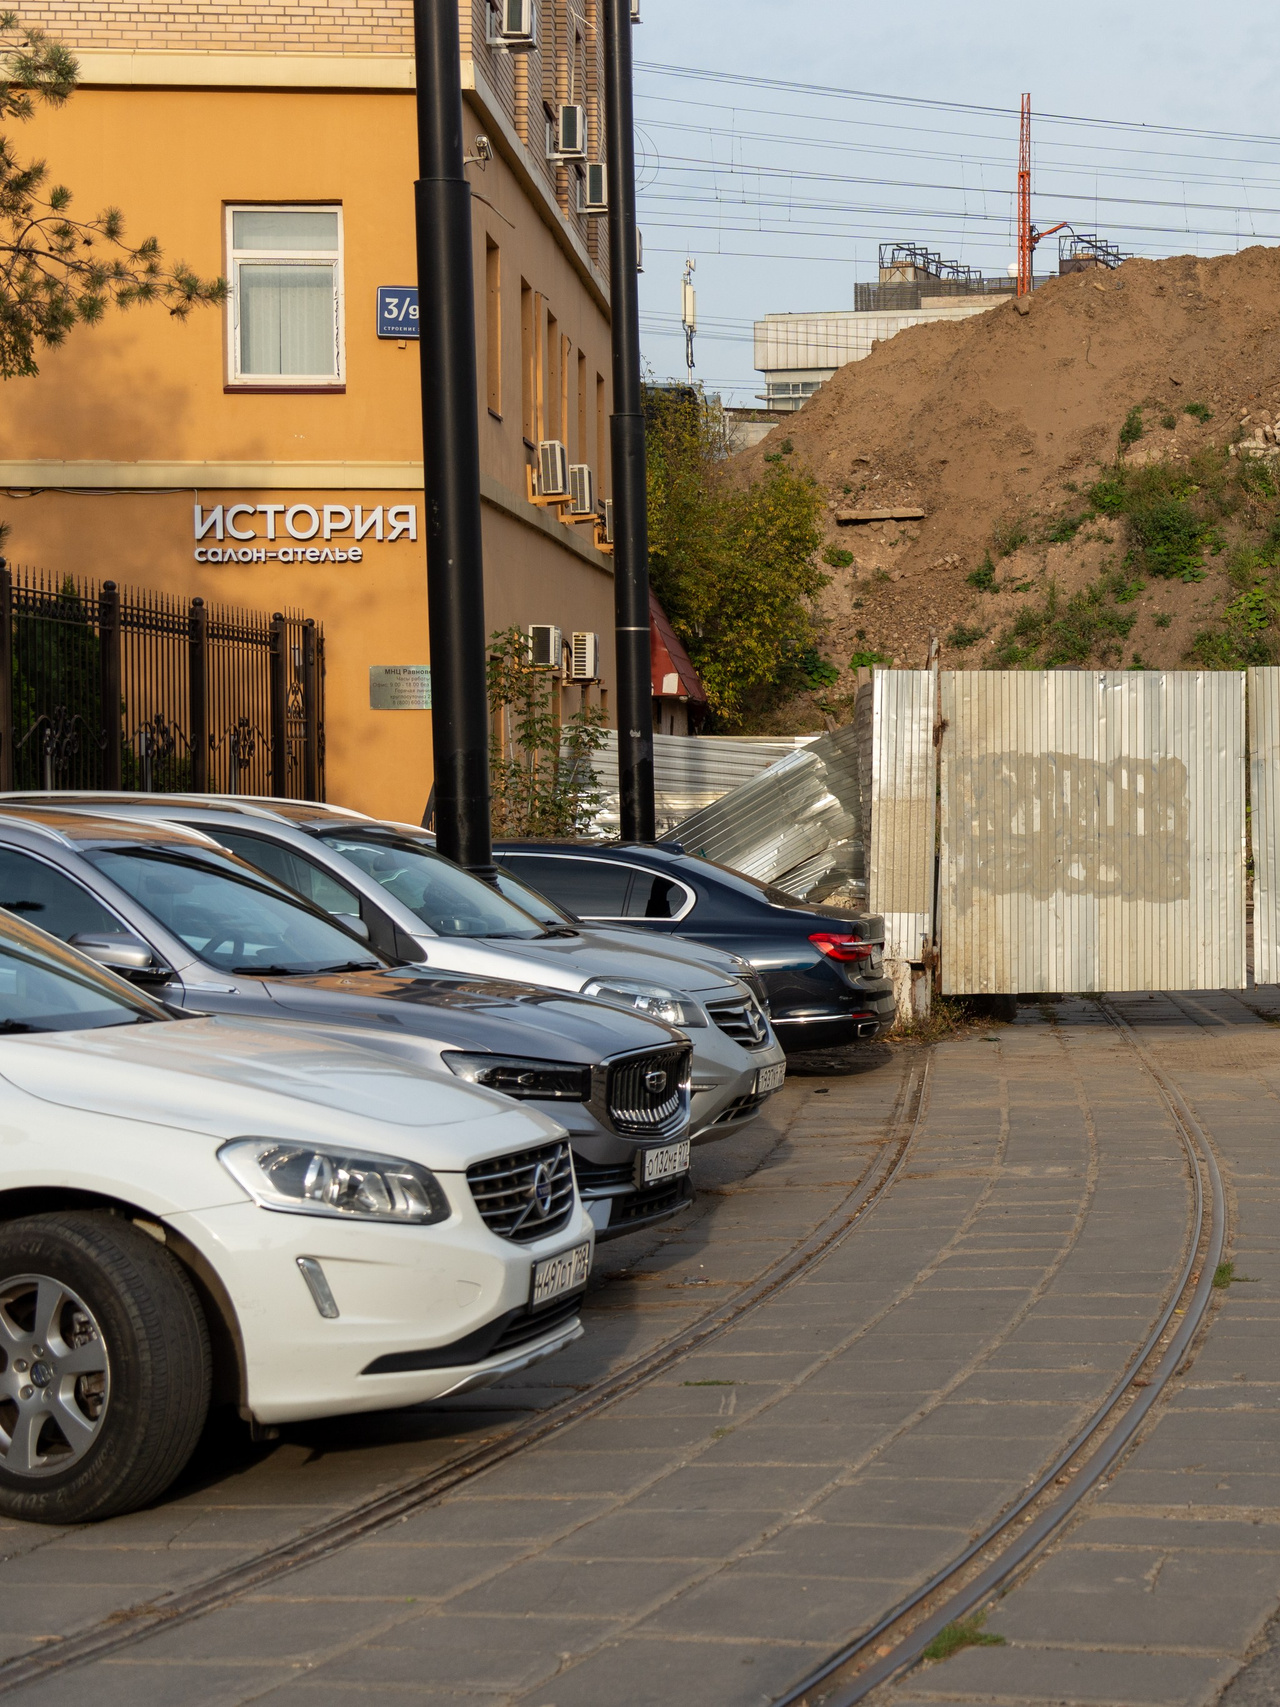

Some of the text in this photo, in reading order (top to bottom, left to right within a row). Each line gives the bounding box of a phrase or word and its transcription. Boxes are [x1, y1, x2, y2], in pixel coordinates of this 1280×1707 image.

[194, 504, 417, 540] ИСТОРИЯ
[194, 547, 363, 563] салон-ателье
[384, 668, 401, 676] МНЦ
[534, 1259, 573, 1299] Н497СТ
